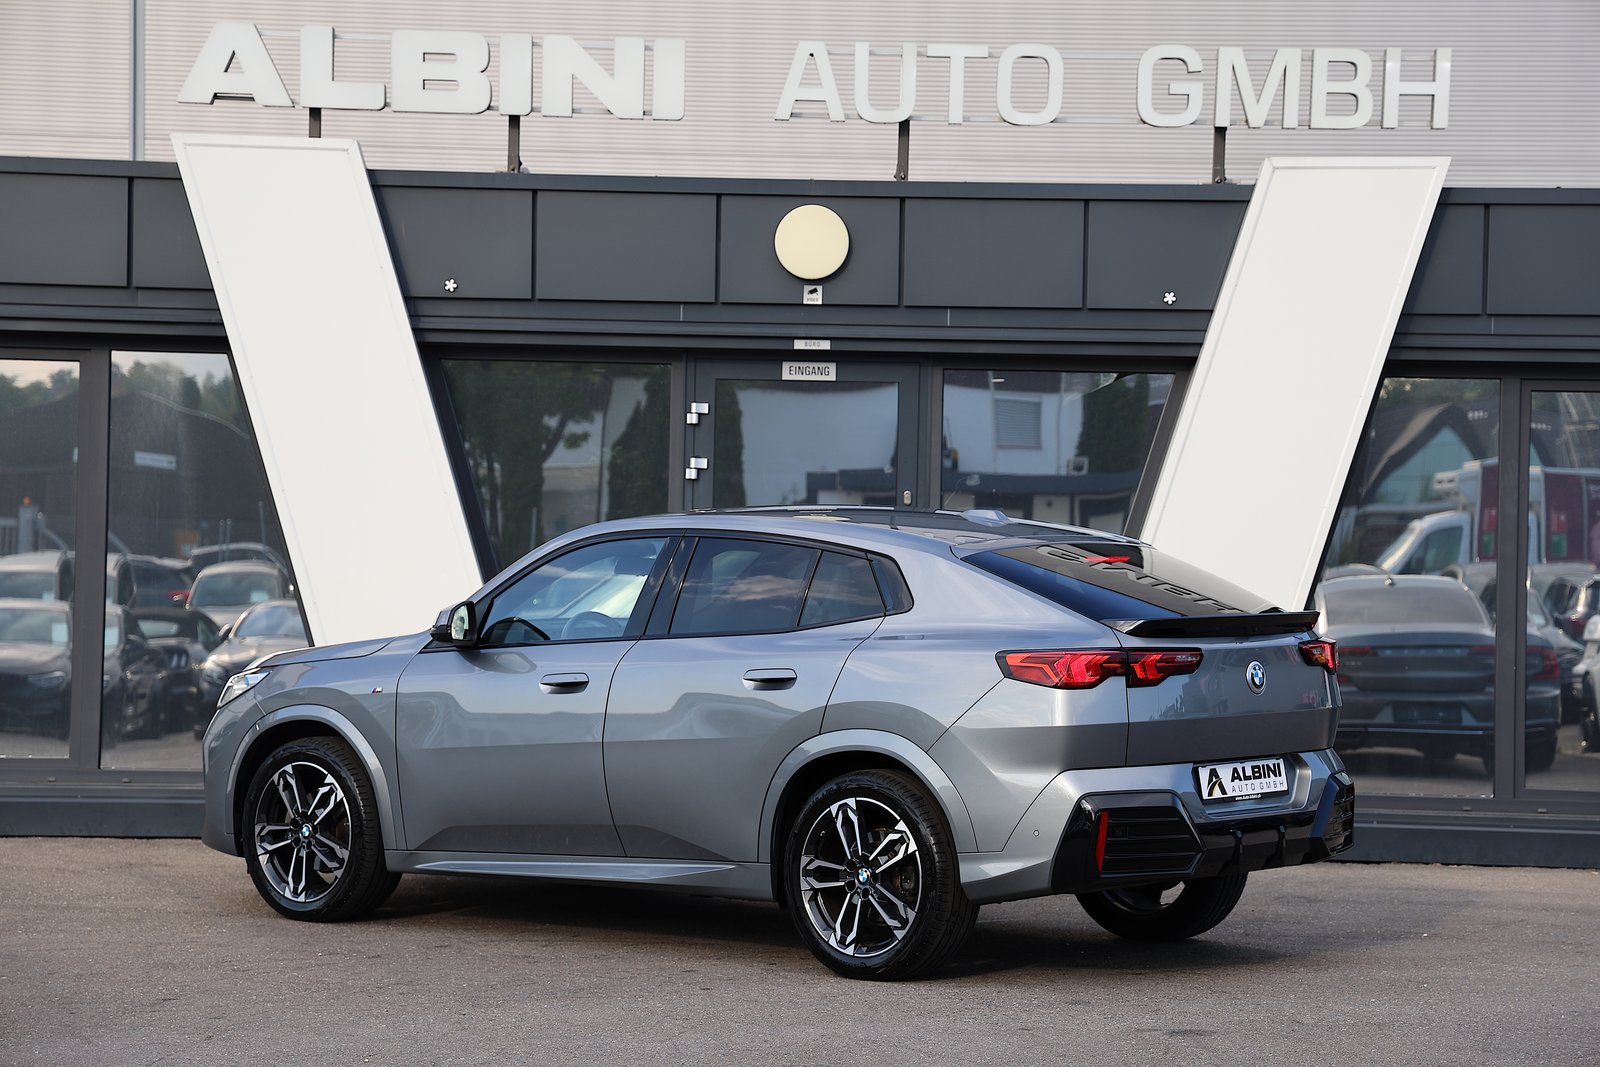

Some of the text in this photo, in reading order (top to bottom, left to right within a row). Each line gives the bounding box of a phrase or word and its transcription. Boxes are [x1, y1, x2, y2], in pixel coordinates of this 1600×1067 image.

[176, 21, 1452, 130] ALBINI AUTO GMBH
[788, 365, 830, 376] EINGANG
[1231, 762, 1282, 783] ALBINI
[1231, 780, 1284, 793] AUTO GMBH
